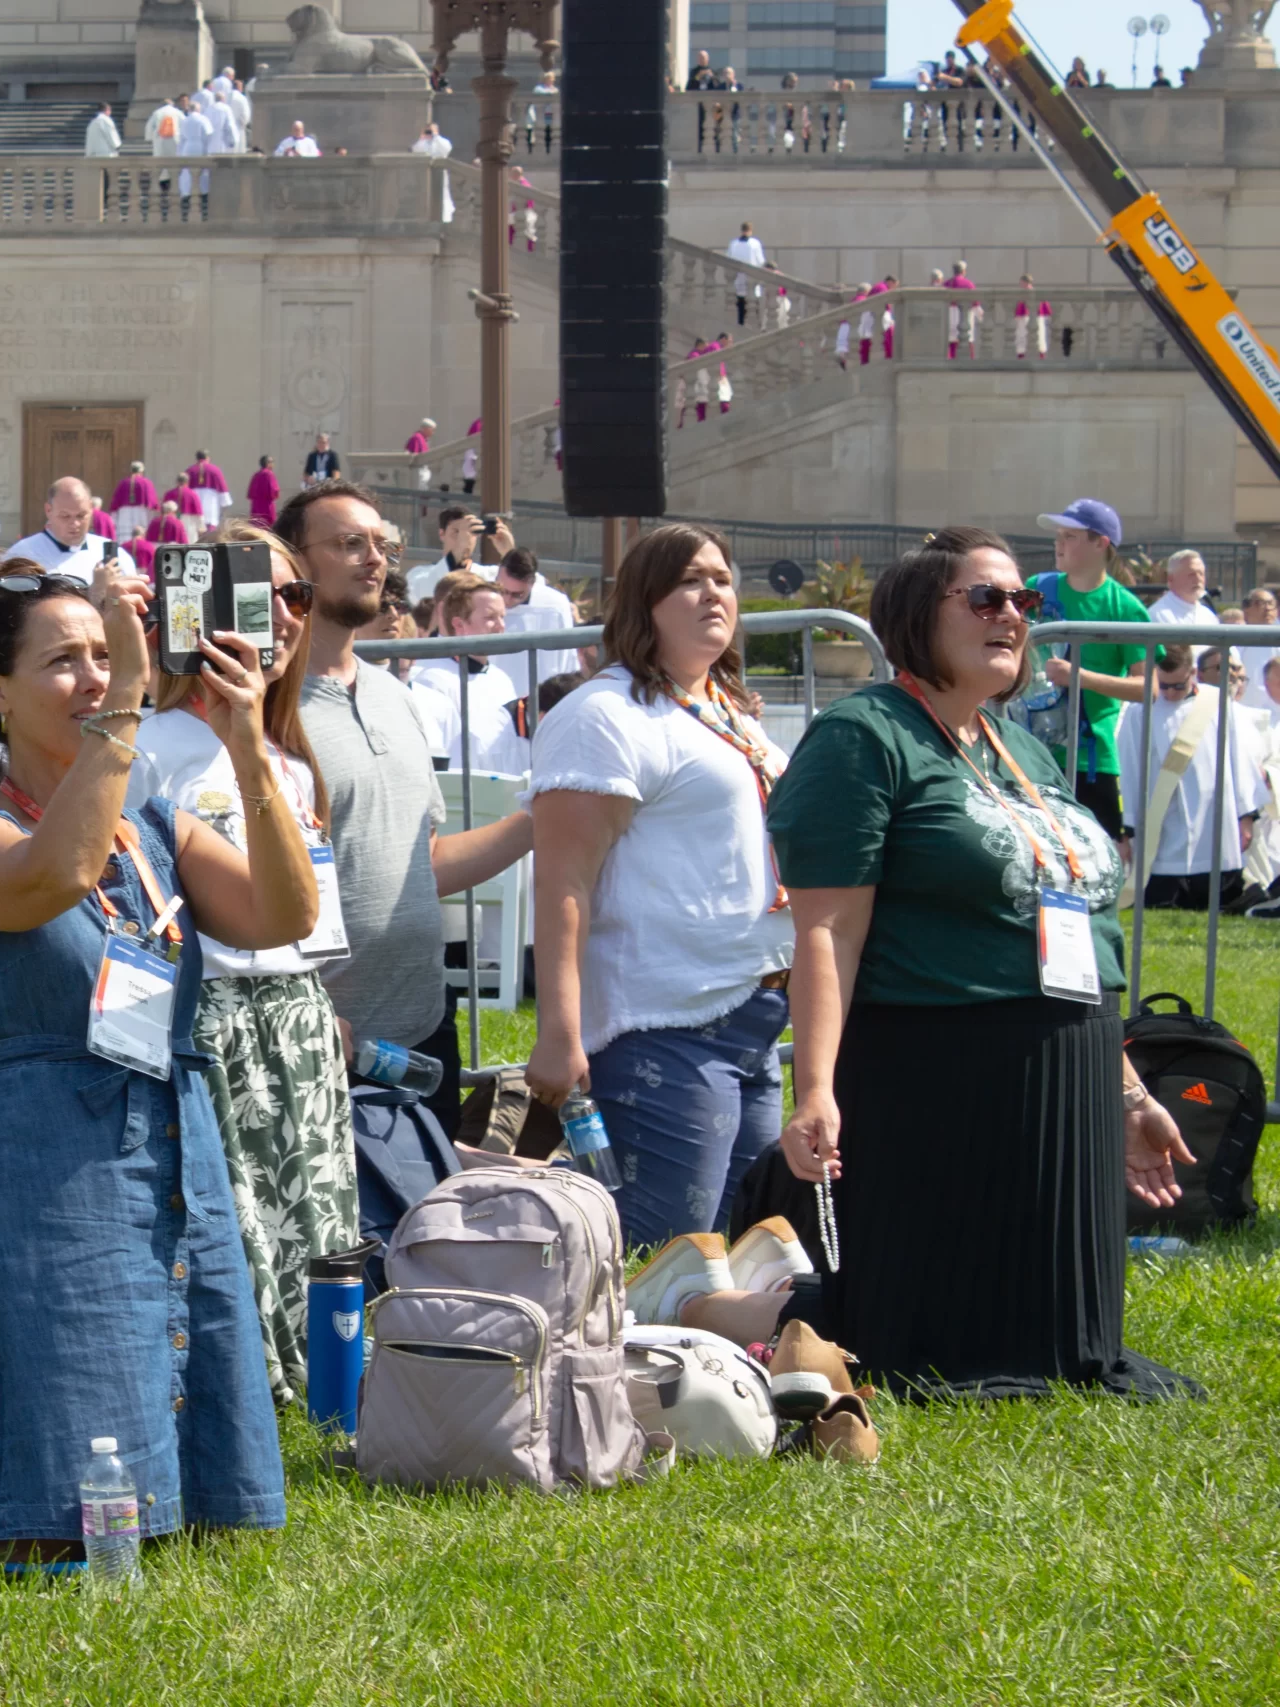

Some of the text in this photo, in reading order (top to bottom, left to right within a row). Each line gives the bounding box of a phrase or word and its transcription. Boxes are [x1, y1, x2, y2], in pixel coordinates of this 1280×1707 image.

[1144, 216, 1197, 273] JCB
[55, 283, 97, 302] THE
[105, 283, 183, 302] UNITED
[41, 307, 62, 325] IN
[65, 307, 109, 325] THE
[111, 307, 184, 325] WORLD
[76, 329, 184, 347] AMERICAN
[1239, 341, 1280, 389] United
[1181, 1092, 1213, 1105] adidas
